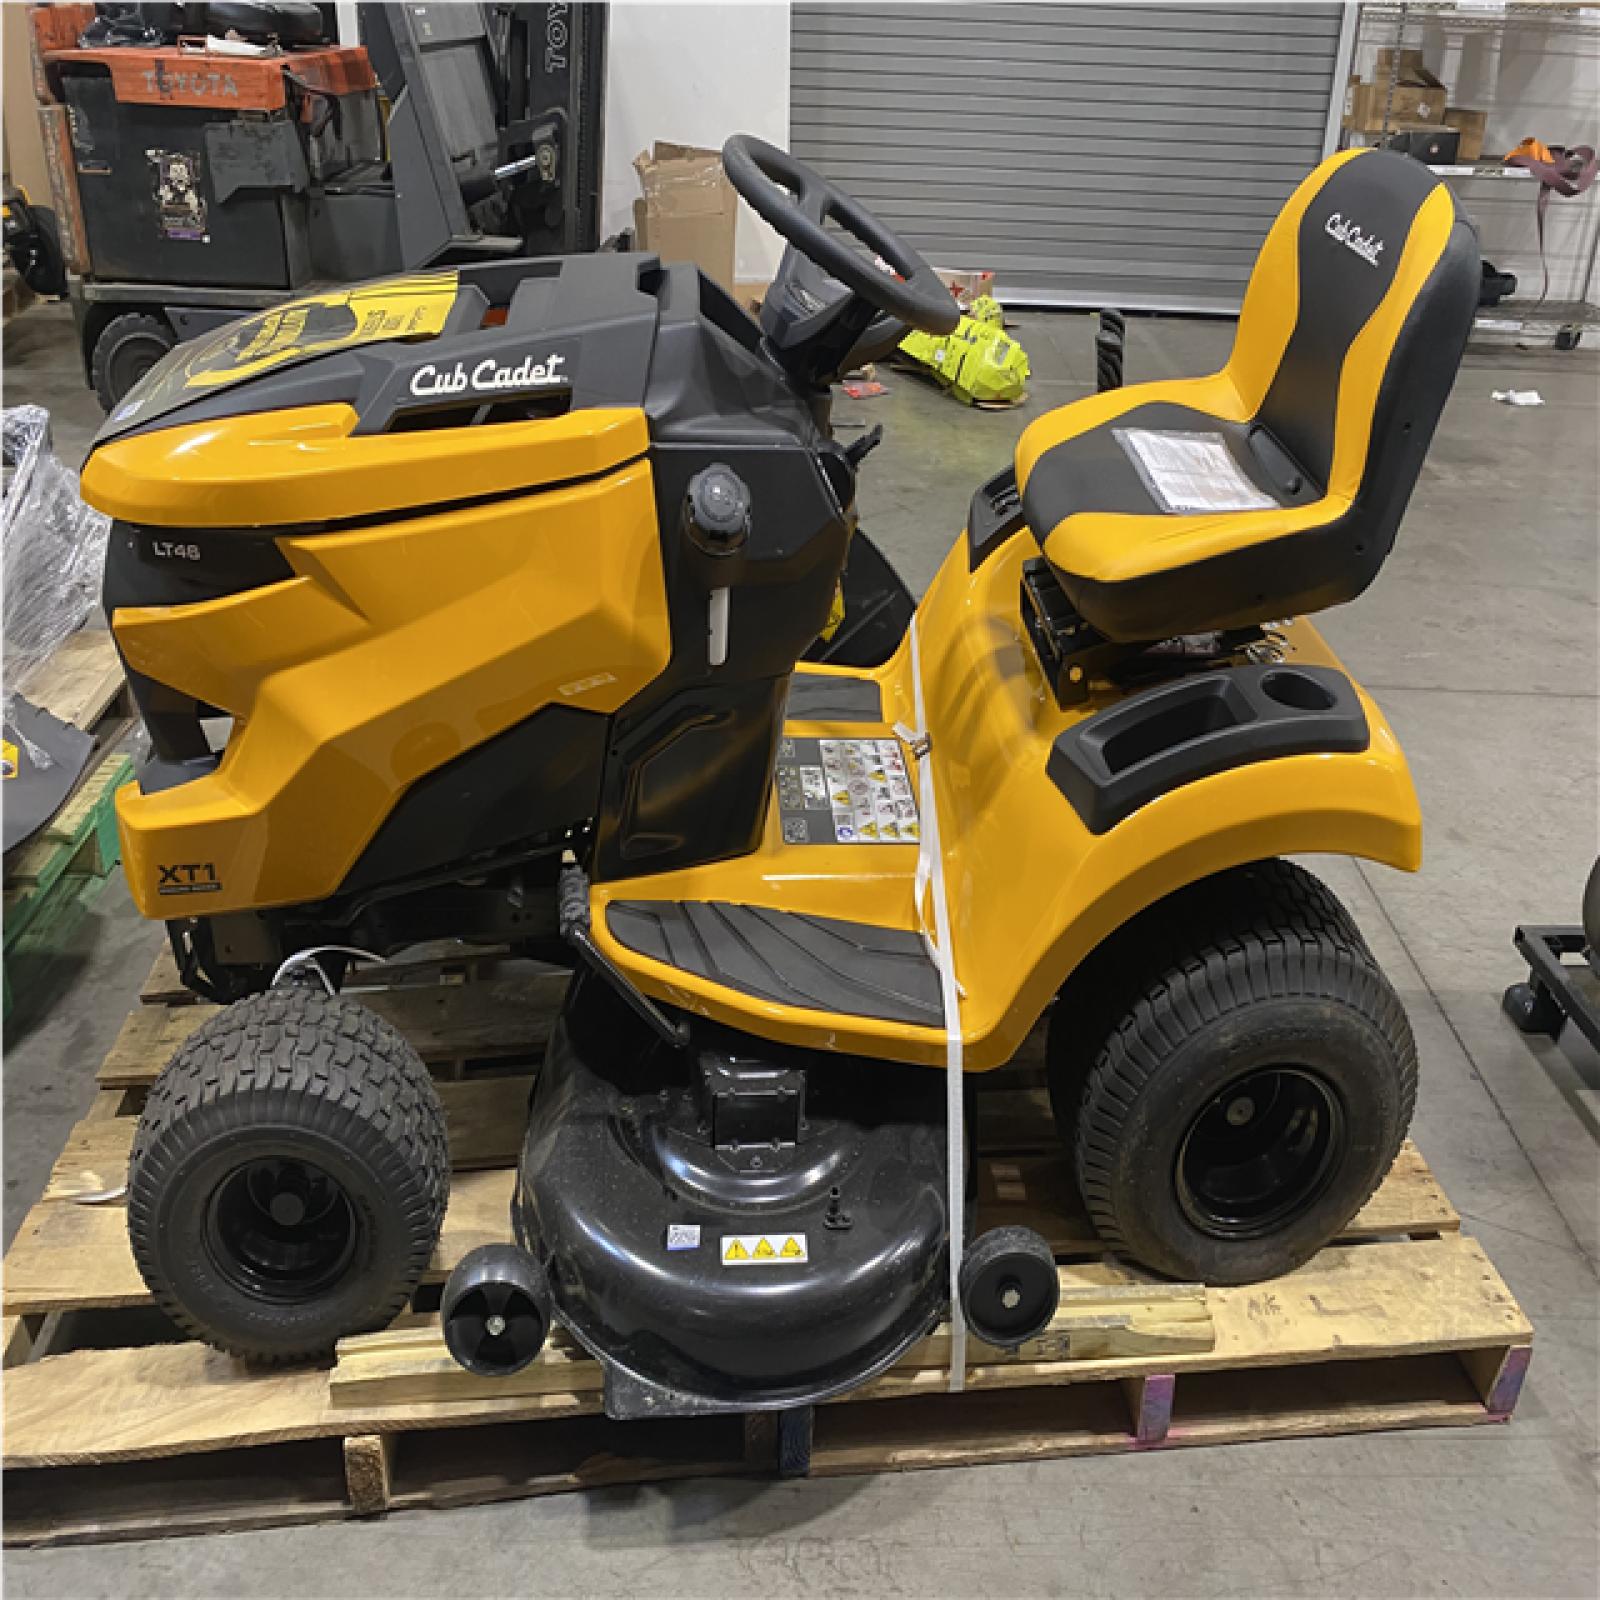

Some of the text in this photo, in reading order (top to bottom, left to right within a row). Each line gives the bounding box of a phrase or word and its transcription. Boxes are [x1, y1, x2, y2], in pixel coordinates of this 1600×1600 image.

[143, 69, 238, 97] TOYOTA
[1345, 226, 1383, 268] Cadet
[410, 352, 566, 396] Cub Cadet
[157, 863, 216, 883] XT1
